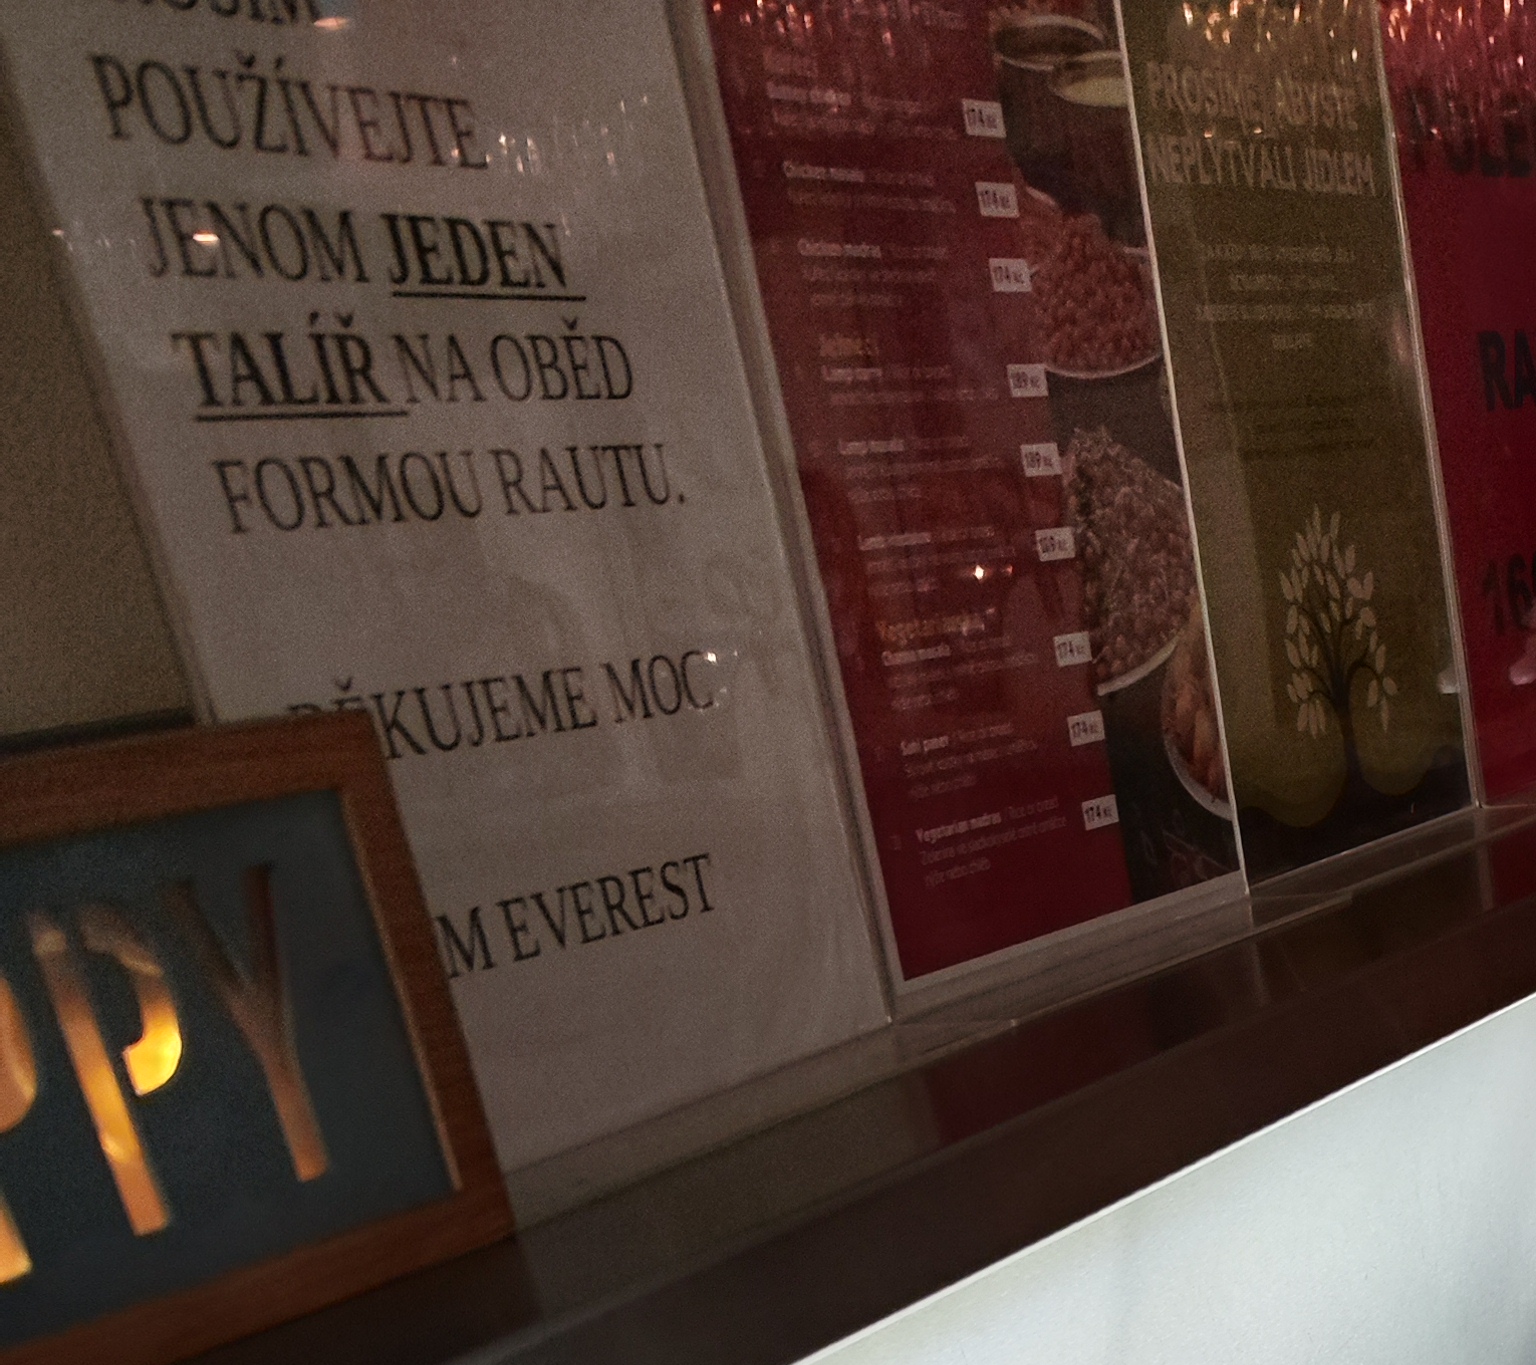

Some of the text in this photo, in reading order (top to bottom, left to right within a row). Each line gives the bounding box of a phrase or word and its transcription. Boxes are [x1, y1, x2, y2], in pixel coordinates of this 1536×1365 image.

[90, 50, 489, 171] POUŽÍVEJTE
[139, 197, 568, 290] JENOM JEDEN
[173, 311, 635, 407] TALÍŘ NA OBĚD
[212, 442, 687, 534] FORMOU RAUTU.
[287, 650, 715, 760] KUJEME MOC
[496, 853, 715, 962] EVEREST
